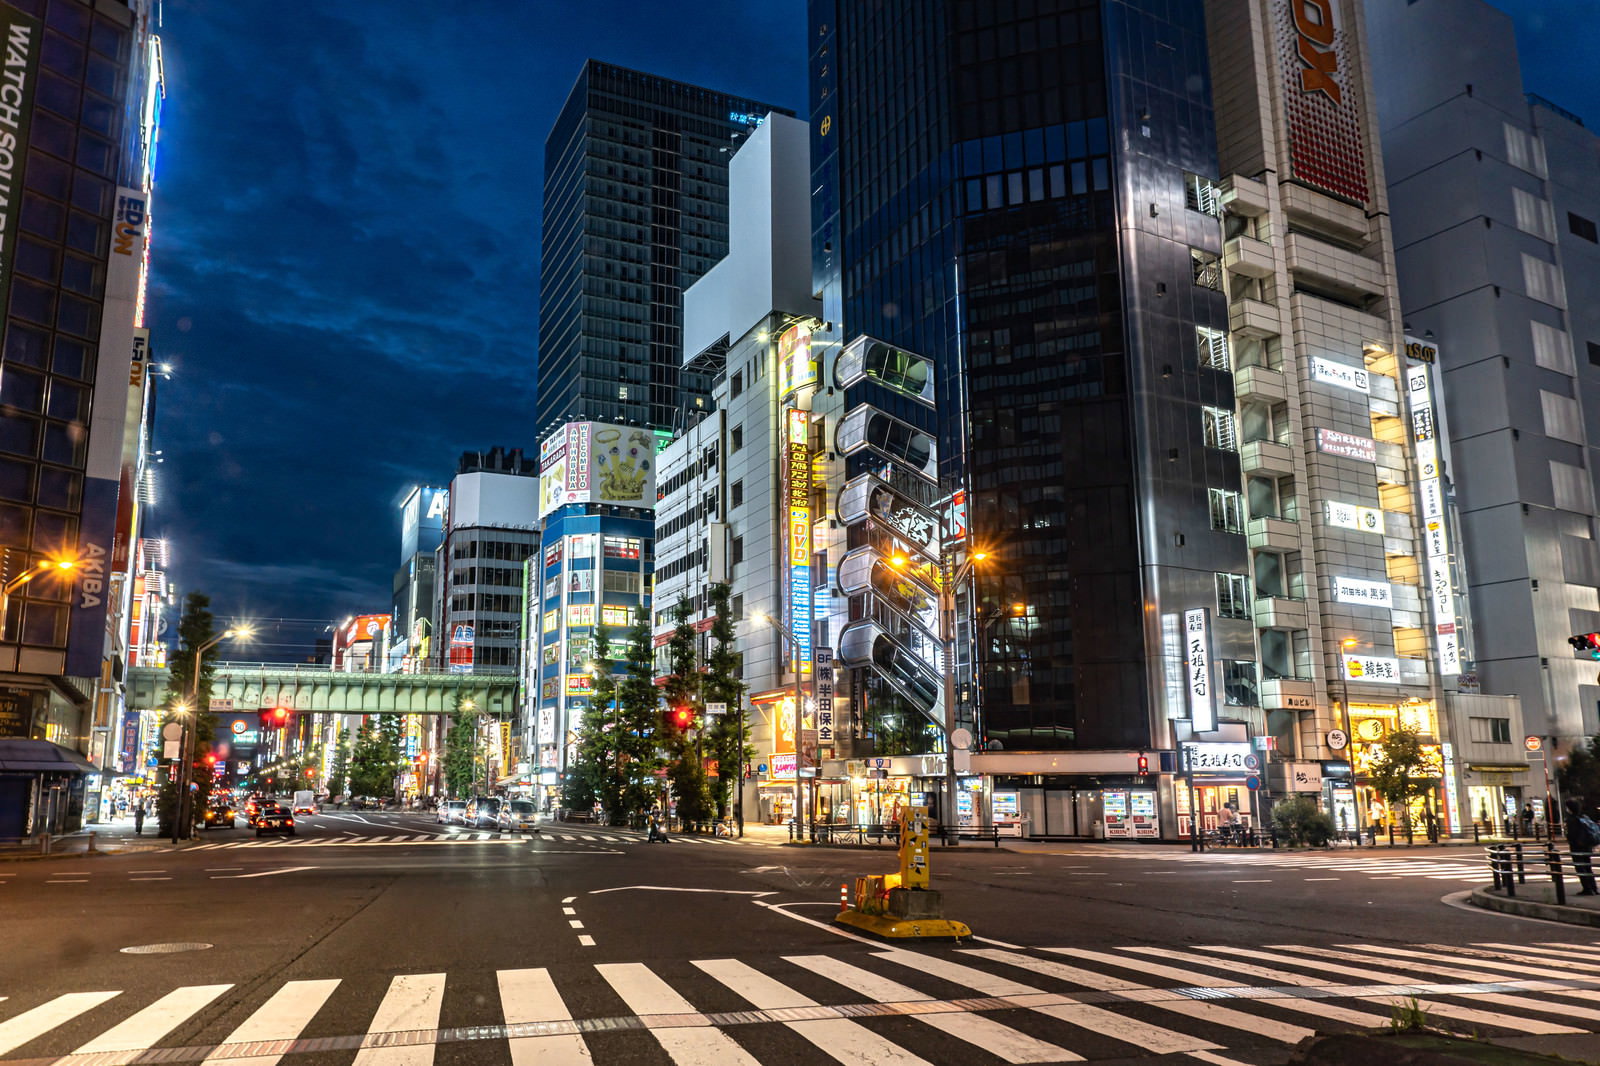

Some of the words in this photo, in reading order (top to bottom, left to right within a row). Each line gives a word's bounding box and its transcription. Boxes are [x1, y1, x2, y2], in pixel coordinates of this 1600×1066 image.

[0, 22, 31, 129] WATCH
[580, 425, 588, 471] WELCOME
[791, 444, 807, 452] ゲーム
[541, 447, 566, 472] TAKARADA
[569, 430, 577, 488] AKIHABARA
[793, 453, 805, 461] CD
[791, 461, 807, 470] アイドル
[580, 475, 587, 488] TO
[791, 470, 807, 479] アニメ
[791, 480, 807, 489] コミック
[792, 489, 807, 498] ホビー
[794, 524, 806, 561] DVD
[80, 542, 106, 609] AKIBA
[1190, 639, 1206, 696] 元祖寿司
[1200, 753, 1242, 767] 元祖寿司
